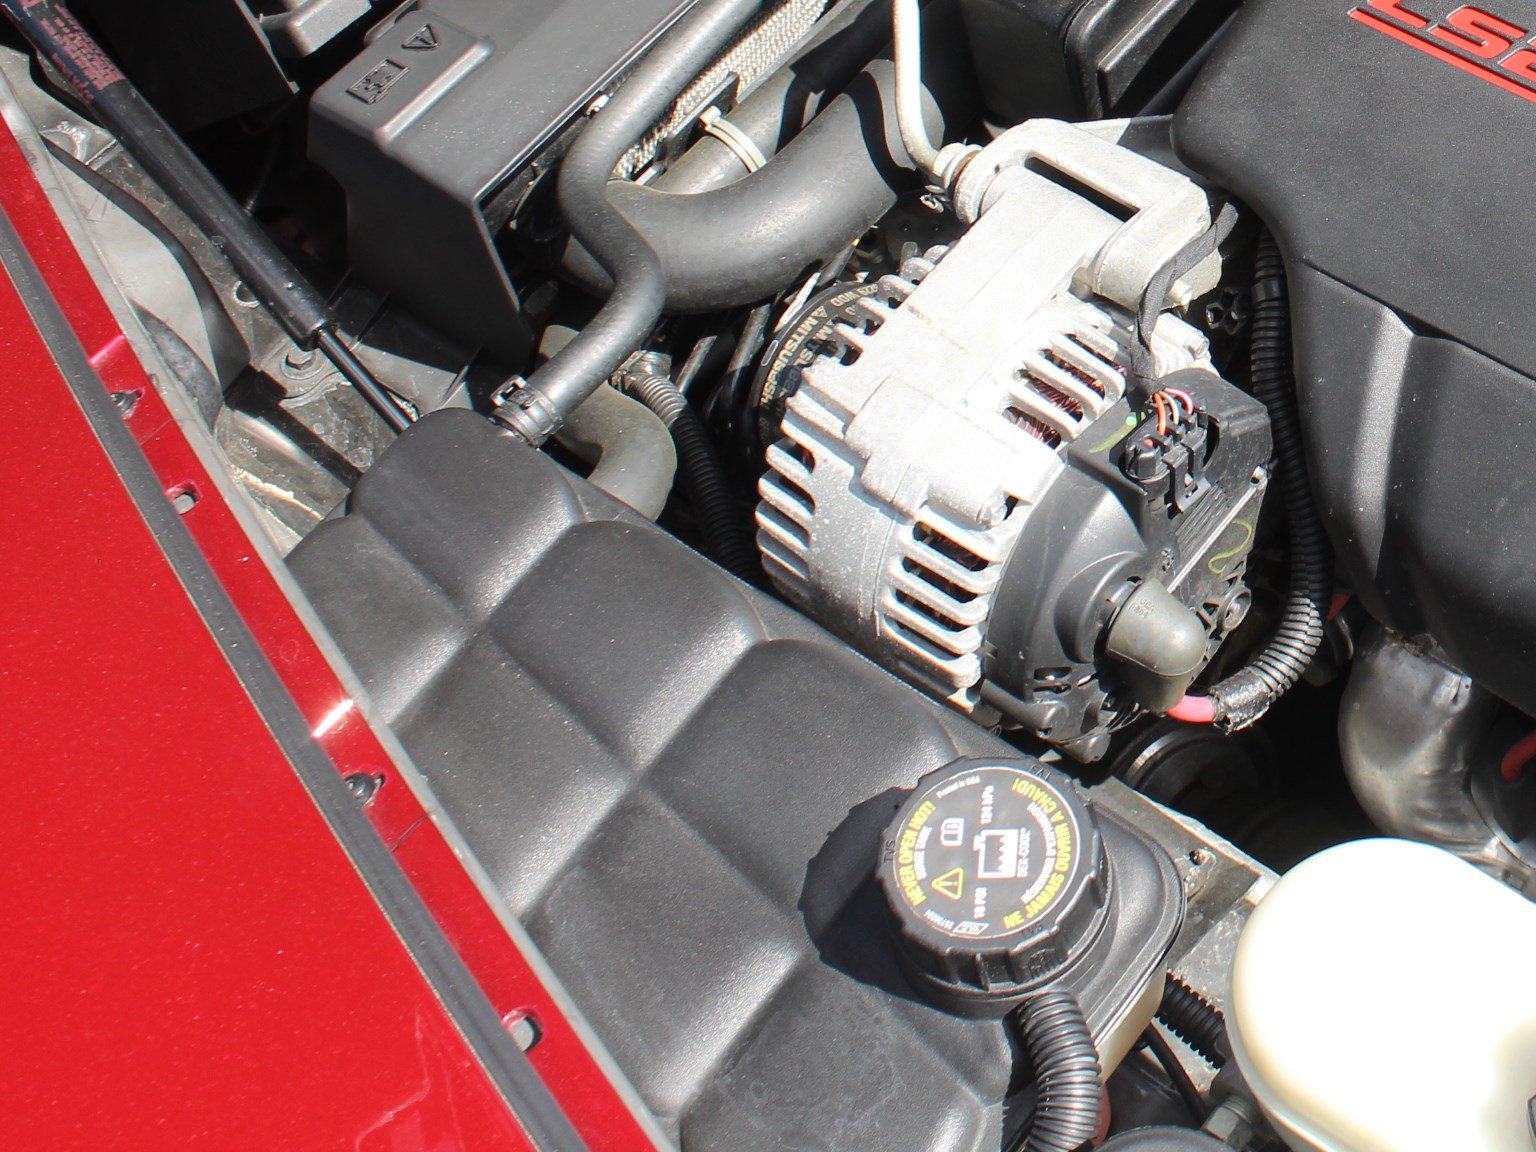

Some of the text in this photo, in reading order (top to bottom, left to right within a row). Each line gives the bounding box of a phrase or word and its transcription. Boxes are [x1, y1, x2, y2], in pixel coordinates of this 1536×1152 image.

[1012, 777, 1053, 813] CHAUD!
[899, 801, 936, 907] NEVER OPEN HOT!
[1054, 822, 1072, 872] OUVRIR
[1025, 872, 1065, 918] JAMAIS
[1003, 910, 1024, 930] NE
